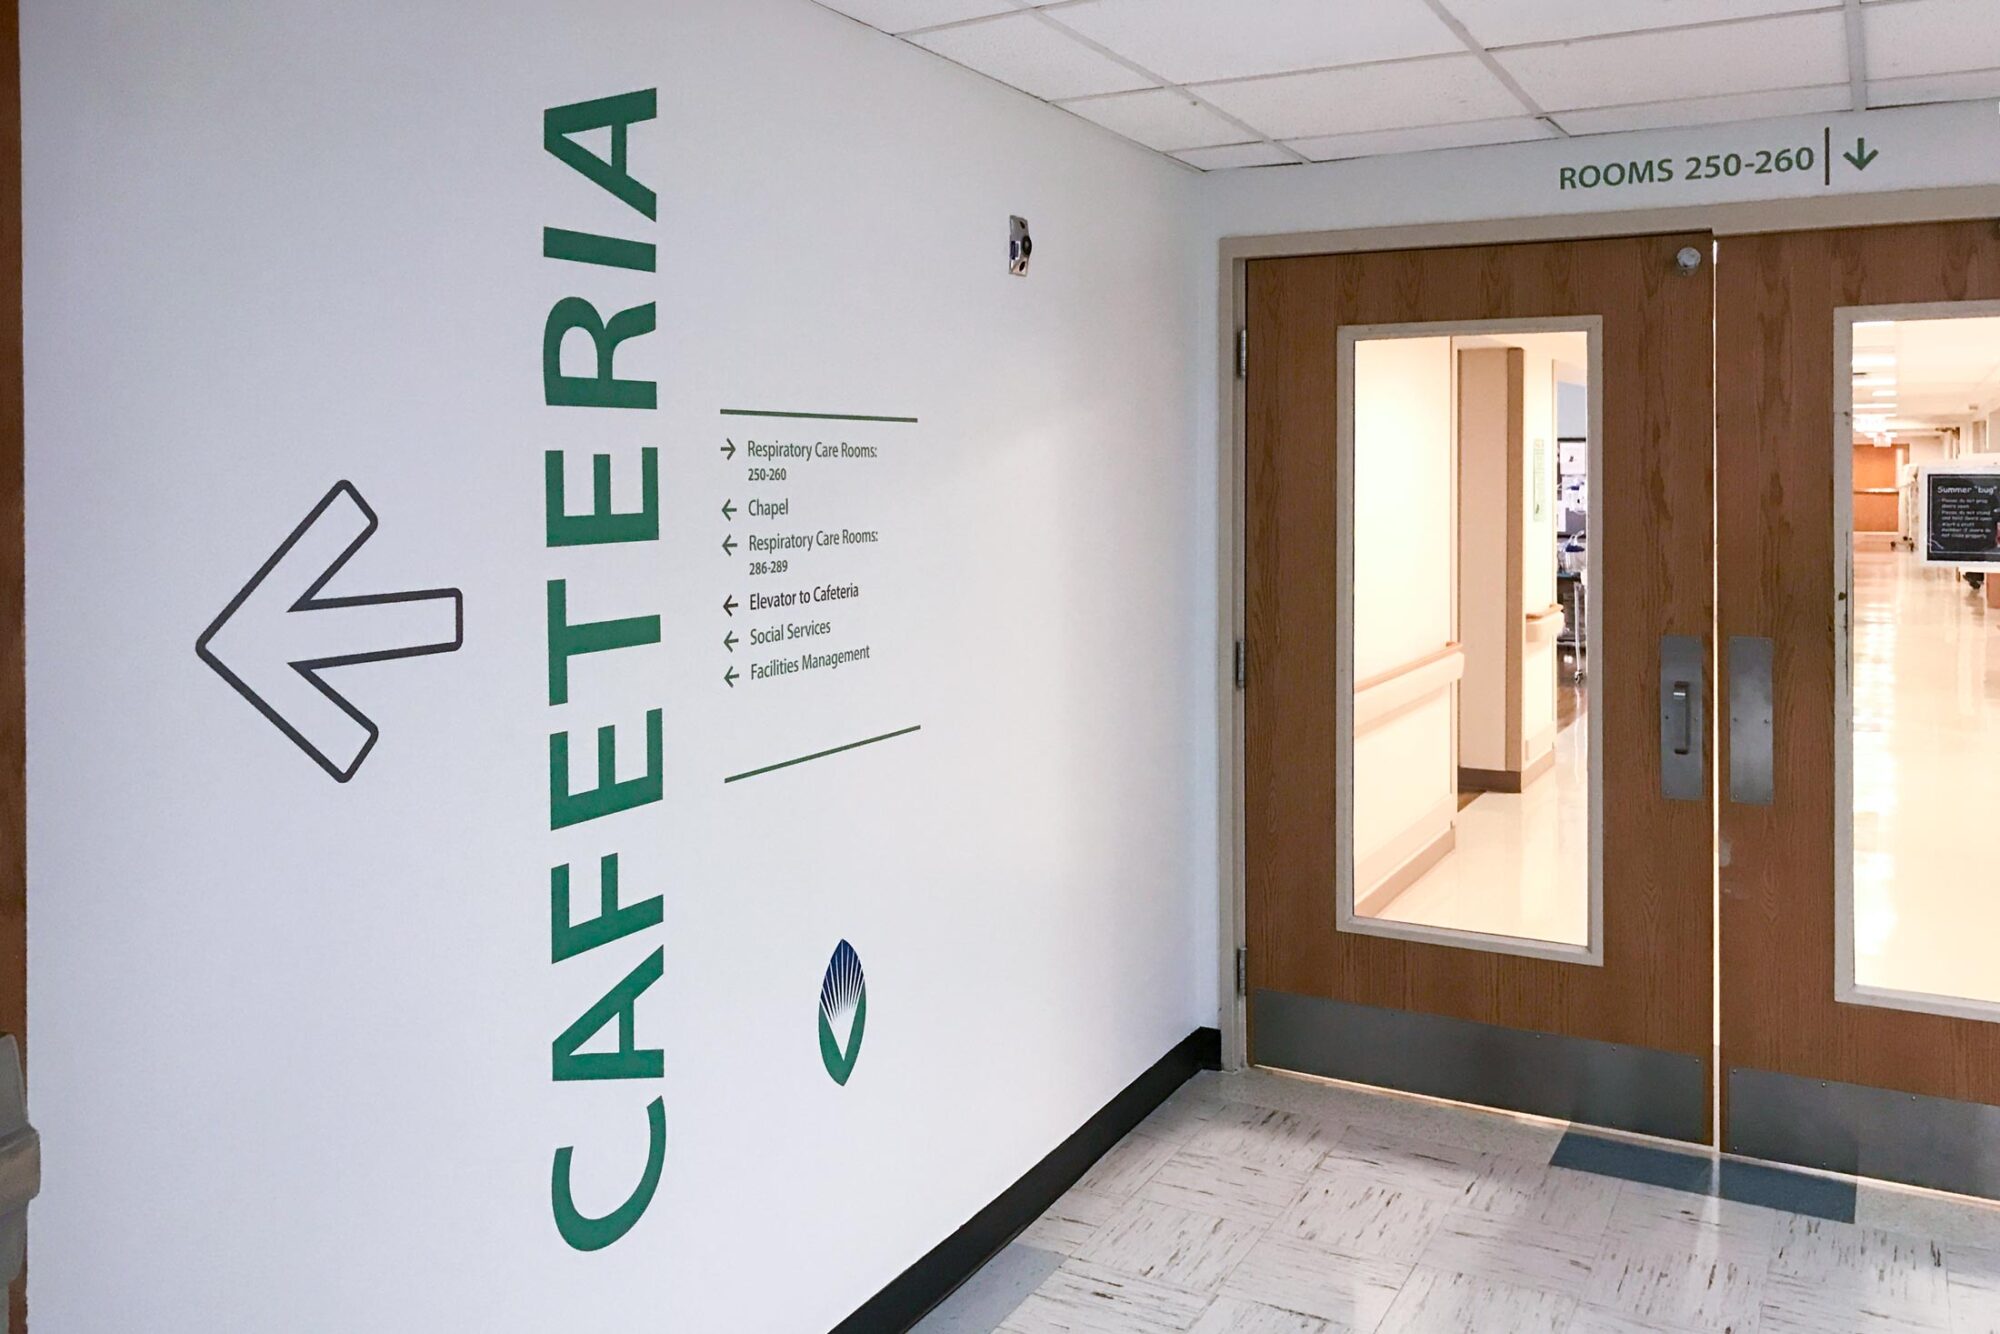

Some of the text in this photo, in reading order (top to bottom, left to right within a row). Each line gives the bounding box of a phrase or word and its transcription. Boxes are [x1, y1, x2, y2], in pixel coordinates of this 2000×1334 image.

[1559, 146, 1815, 190] ROOMS 250-260
[747, 440, 878, 462] Respiratory Care Rooms:
[747, 468, 787, 481] 250-260
[1937, 486, 1972, 494] Summer
[748, 498, 789, 520] Chapel
[748, 528, 879, 554] Respiratory Care Rooms:
[749, 559, 789, 576] 286-289
[749, 582, 859, 611] Elevator to Cafeteria
[750, 619, 831, 646] Social Services
[543, 87, 667, 1252] CAFETERIA
[751, 645, 870, 681] Facilities Management
